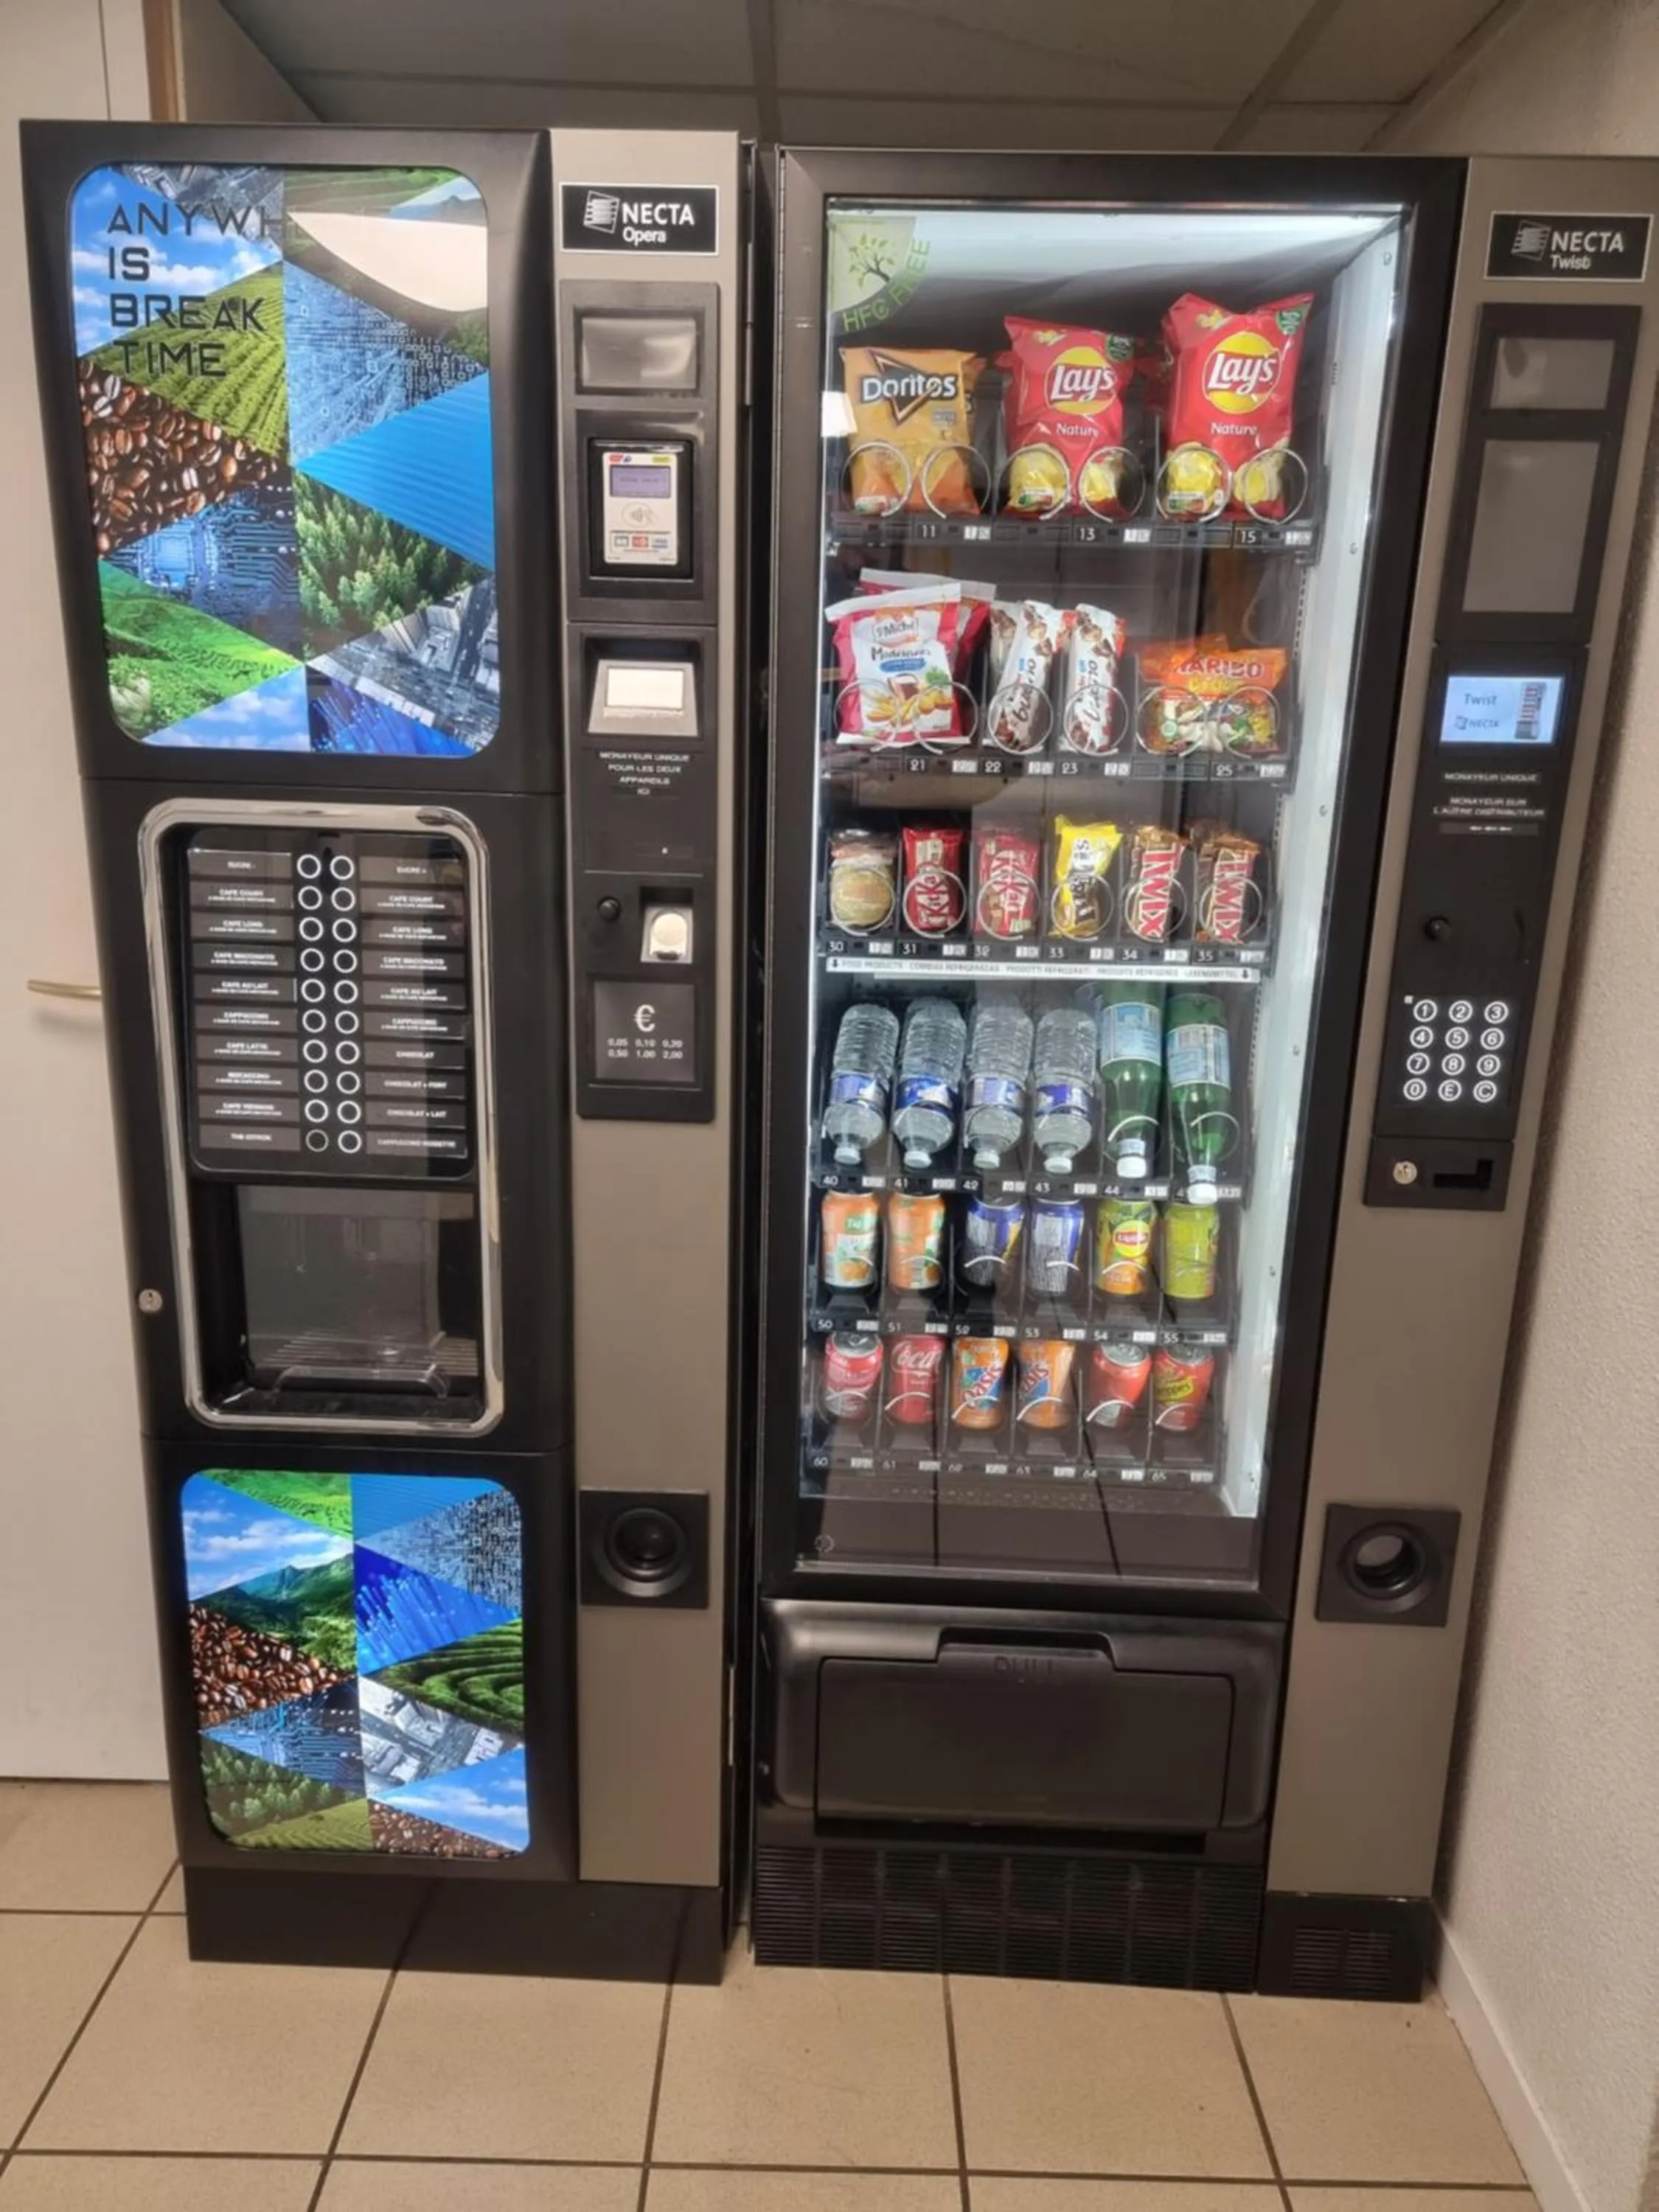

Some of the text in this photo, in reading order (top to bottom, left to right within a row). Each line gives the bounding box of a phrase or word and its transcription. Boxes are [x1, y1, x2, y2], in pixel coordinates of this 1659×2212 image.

[622, 201, 695, 226] NECTA
[623, 226, 667, 247] Opera
[1551, 230, 1625, 254] NECTA
[108, 247, 150, 282] IS
[110, 293, 266, 331] BREAK
[114, 341, 226, 377] TIME
[1207, 352, 1279, 395] Lay's
[861, 375, 958, 403] Doritos
[1051, 364, 1116, 406] Lay's
[1211, 422, 1257, 436] Nature
[922, 525, 936, 538] 11
[1080, 528, 1096, 541] 13
[1241, 530, 1256, 543] 15
[1464, 693, 1498, 707] Twist
[608, 763, 634, 772] POUR
[636, 765, 654, 773] LES
[910, 759, 925, 771] 21
[1062, 762, 1078, 774] 23
[1217, 764, 1233, 776] 25
[829, 942, 844, 953] 30
[902, 943, 917, 955] 31
[1049, 946, 1064, 959] 33
[1121, 947, 1138, 961] 34
[1197, 949, 1214, 962] 35
[633, 1004, 656, 1032] €
[1422, 1004, 1501, 1019] 1 2 3
[1416, 1031, 1498, 1045] 4 5 6
[1414, 1057, 1493, 1071] 7 8 9
[1411, 1084, 1492, 1097] 0 E C
[823, 1175, 839, 1186] 40
[894, 1178, 908, 1188] 41
[963, 1180, 979, 1191] 42
[1034, 1182, 1051, 1193] 43
[1105, 1184, 1120, 1196] 44
[818, 1320, 833, 1329] 50
[1025, 1327, 1040, 1338] 53
[1093, 1330, 1108, 1340] 54
[813, 1457, 829, 1467] 60
